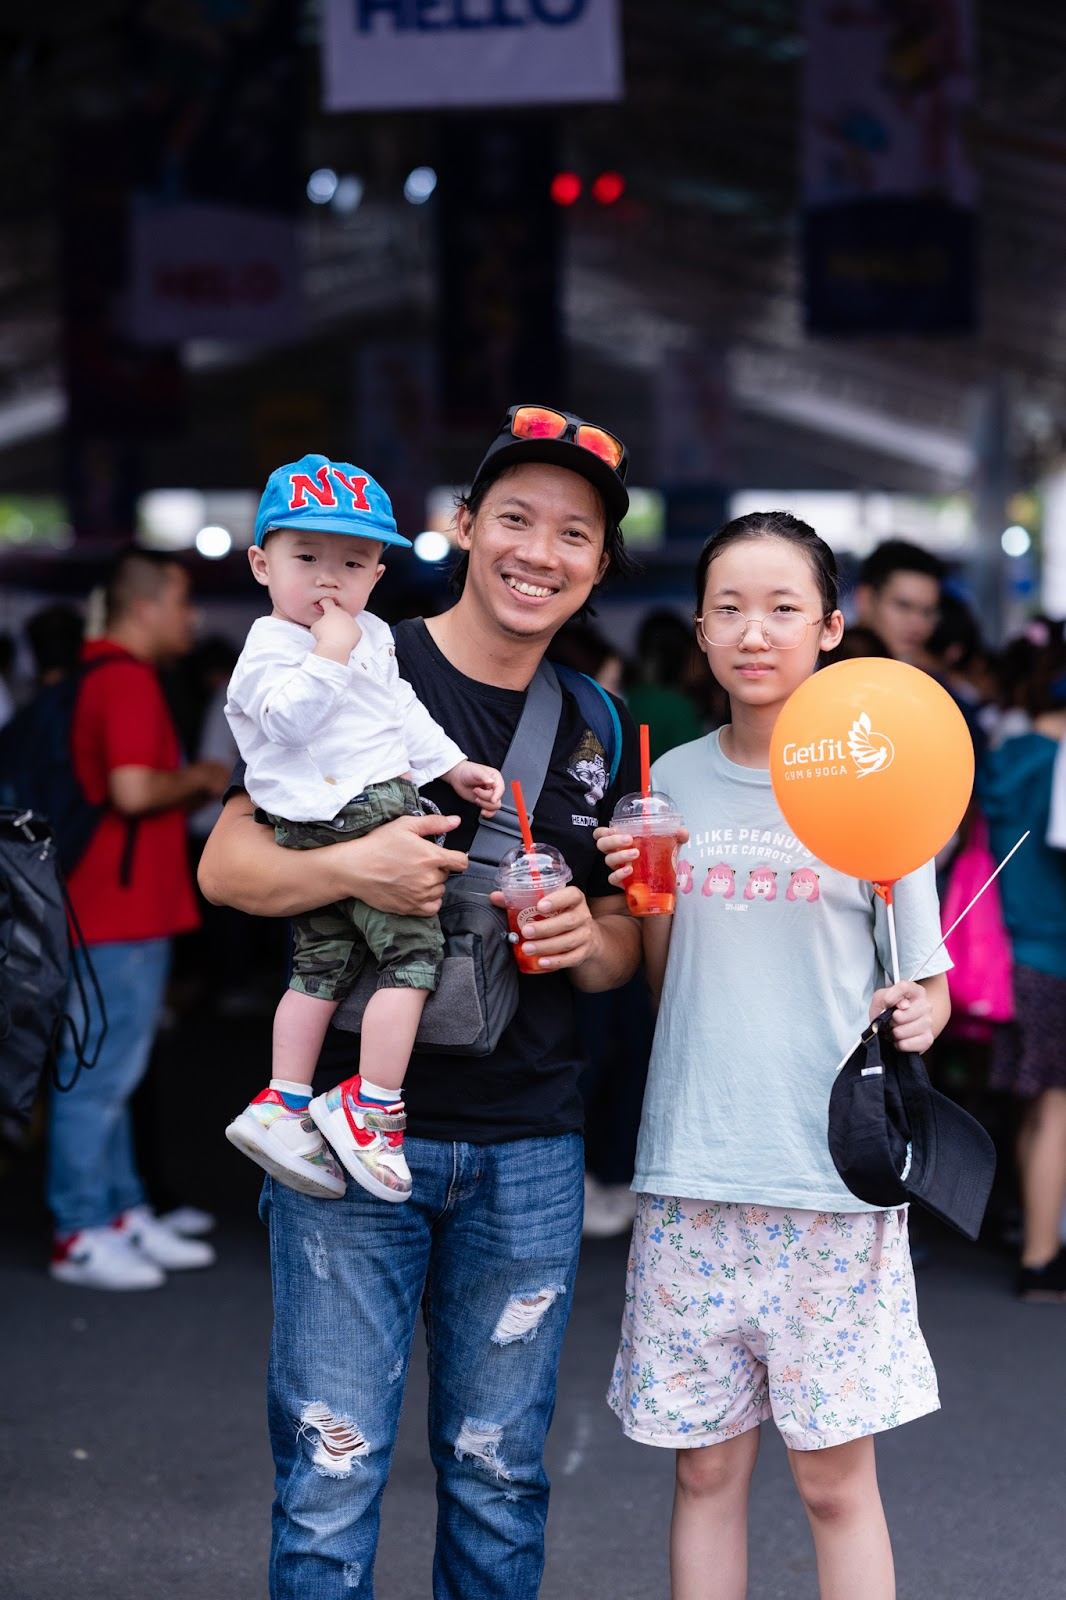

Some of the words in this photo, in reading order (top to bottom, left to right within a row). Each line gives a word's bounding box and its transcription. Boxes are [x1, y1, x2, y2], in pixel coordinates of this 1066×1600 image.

[289, 464, 372, 512] NY
[783, 738, 847, 766] Getfit
[784, 770, 804, 781] GYM
[806, 769, 812, 778] &
[815, 765, 848, 777] YOGA
[695, 828, 733, 846] LIKE
[700, 849, 704, 858] I
[707, 844, 738, 857] HATE
[740, 845, 793, 864] CARROTS
